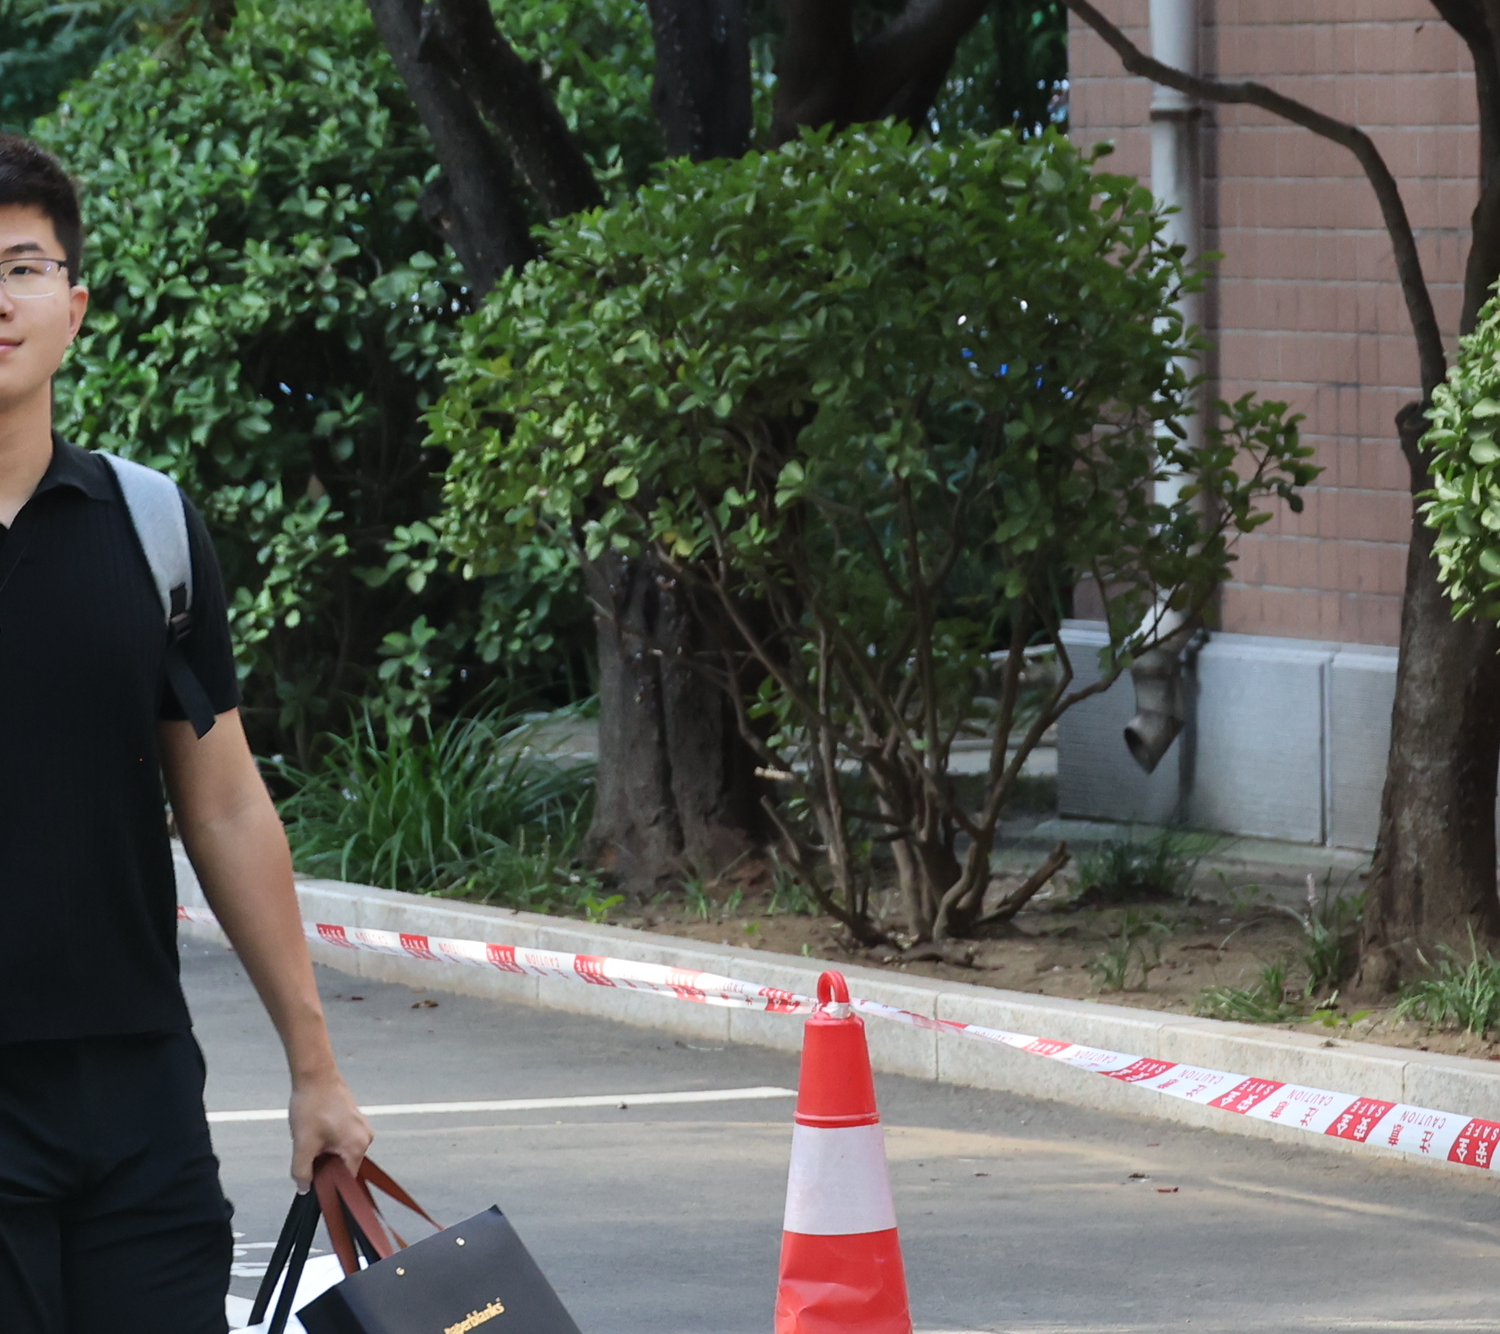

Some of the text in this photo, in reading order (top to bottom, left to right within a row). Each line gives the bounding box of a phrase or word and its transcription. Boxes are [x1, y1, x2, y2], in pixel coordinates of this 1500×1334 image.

[1177, 1068, 1225, 1085] CAUTION
[1239, 1080, 1275, 1096] SAFE
[1287, 1089, 1334, 1107] CAUTION
[1350, 1100, 1386, 1118] SAFE
[1401, 1110, 1447, 1130] CAUTION
[1465, 1122, 1500, 1142] SAFE
[1336, 1113, 1373, 1140] 安全
[1388, 1123, 1435, 1154] 注意
[1455, 1137, 1489, 1166] 安全
